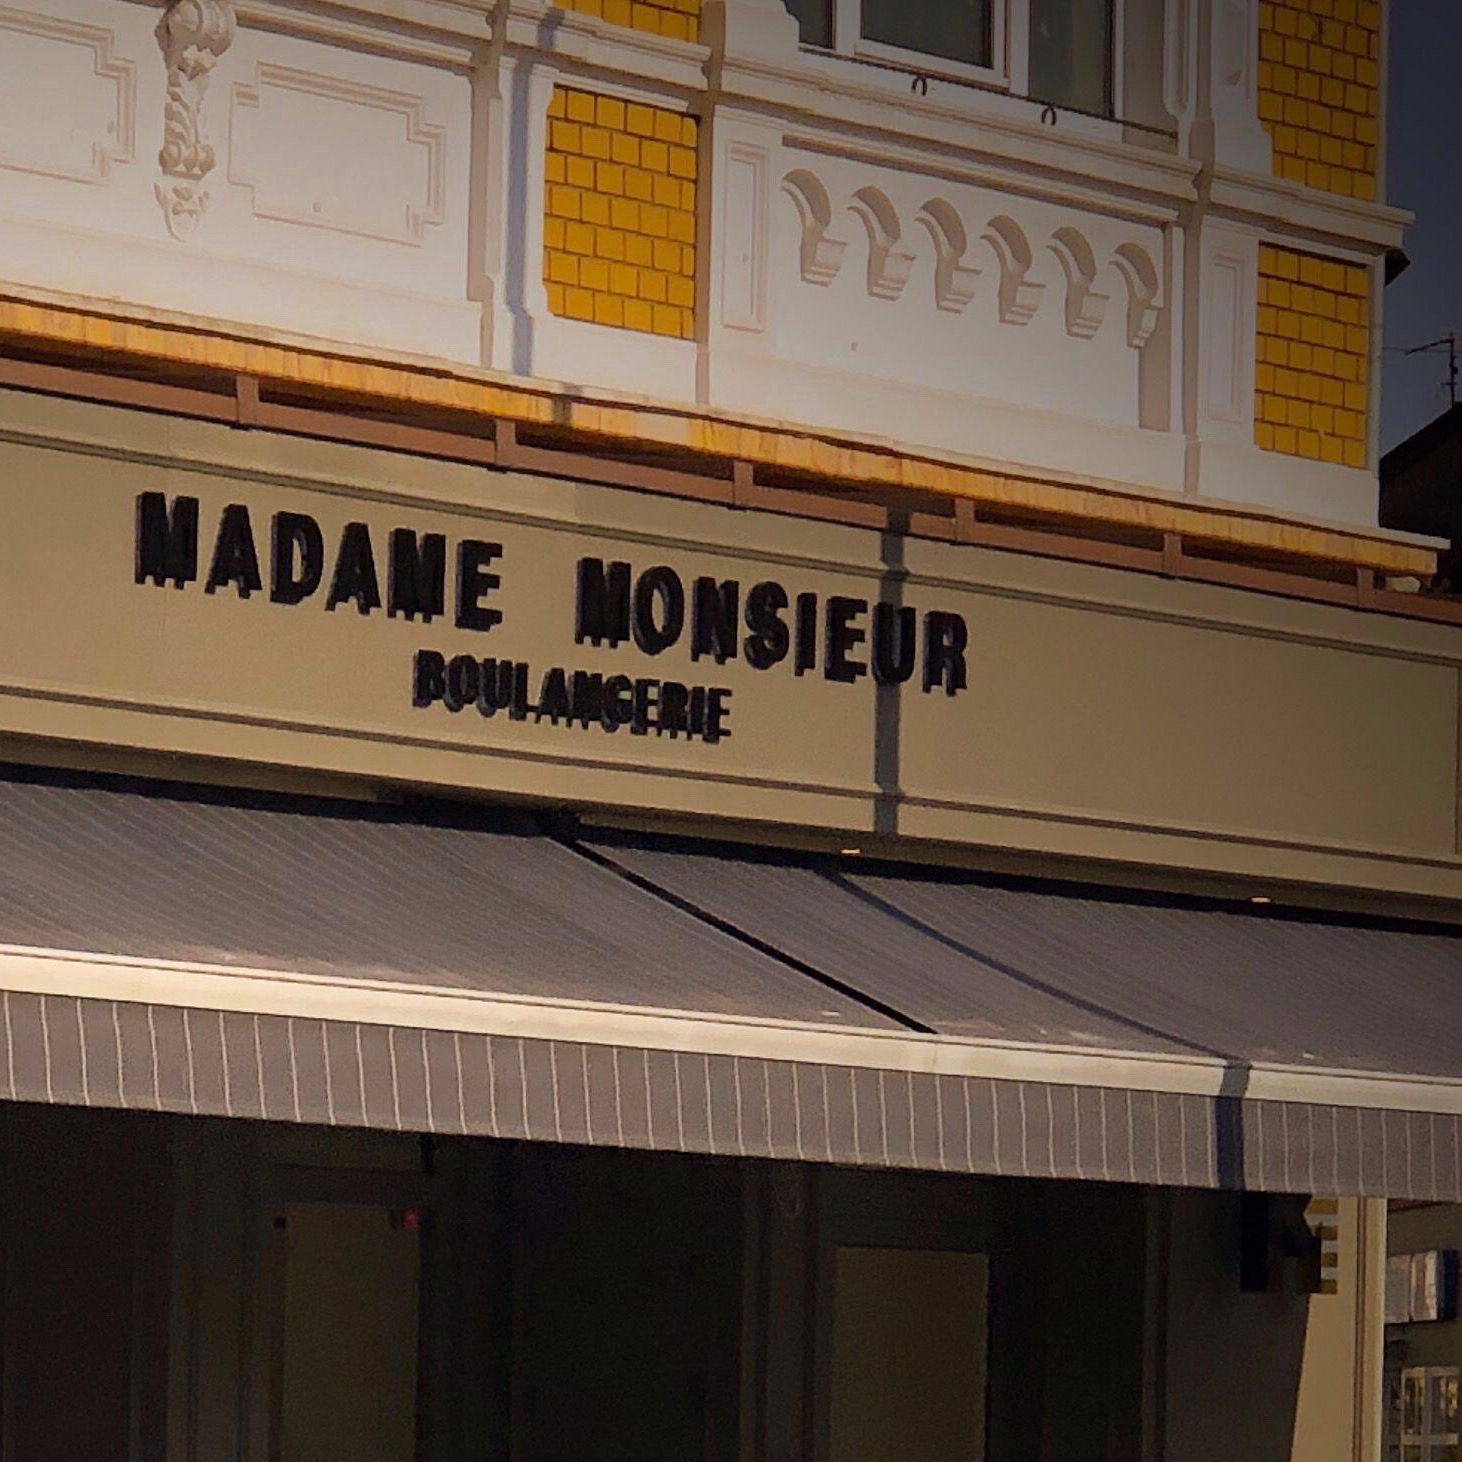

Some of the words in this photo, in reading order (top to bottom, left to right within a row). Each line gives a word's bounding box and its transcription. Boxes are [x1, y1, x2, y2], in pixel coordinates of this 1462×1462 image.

[135, 491, 504, 633] MADAME
[574, 556, 970, 698] MONSIEUR
[412, 648, 733, 745] BOULANGERIE
